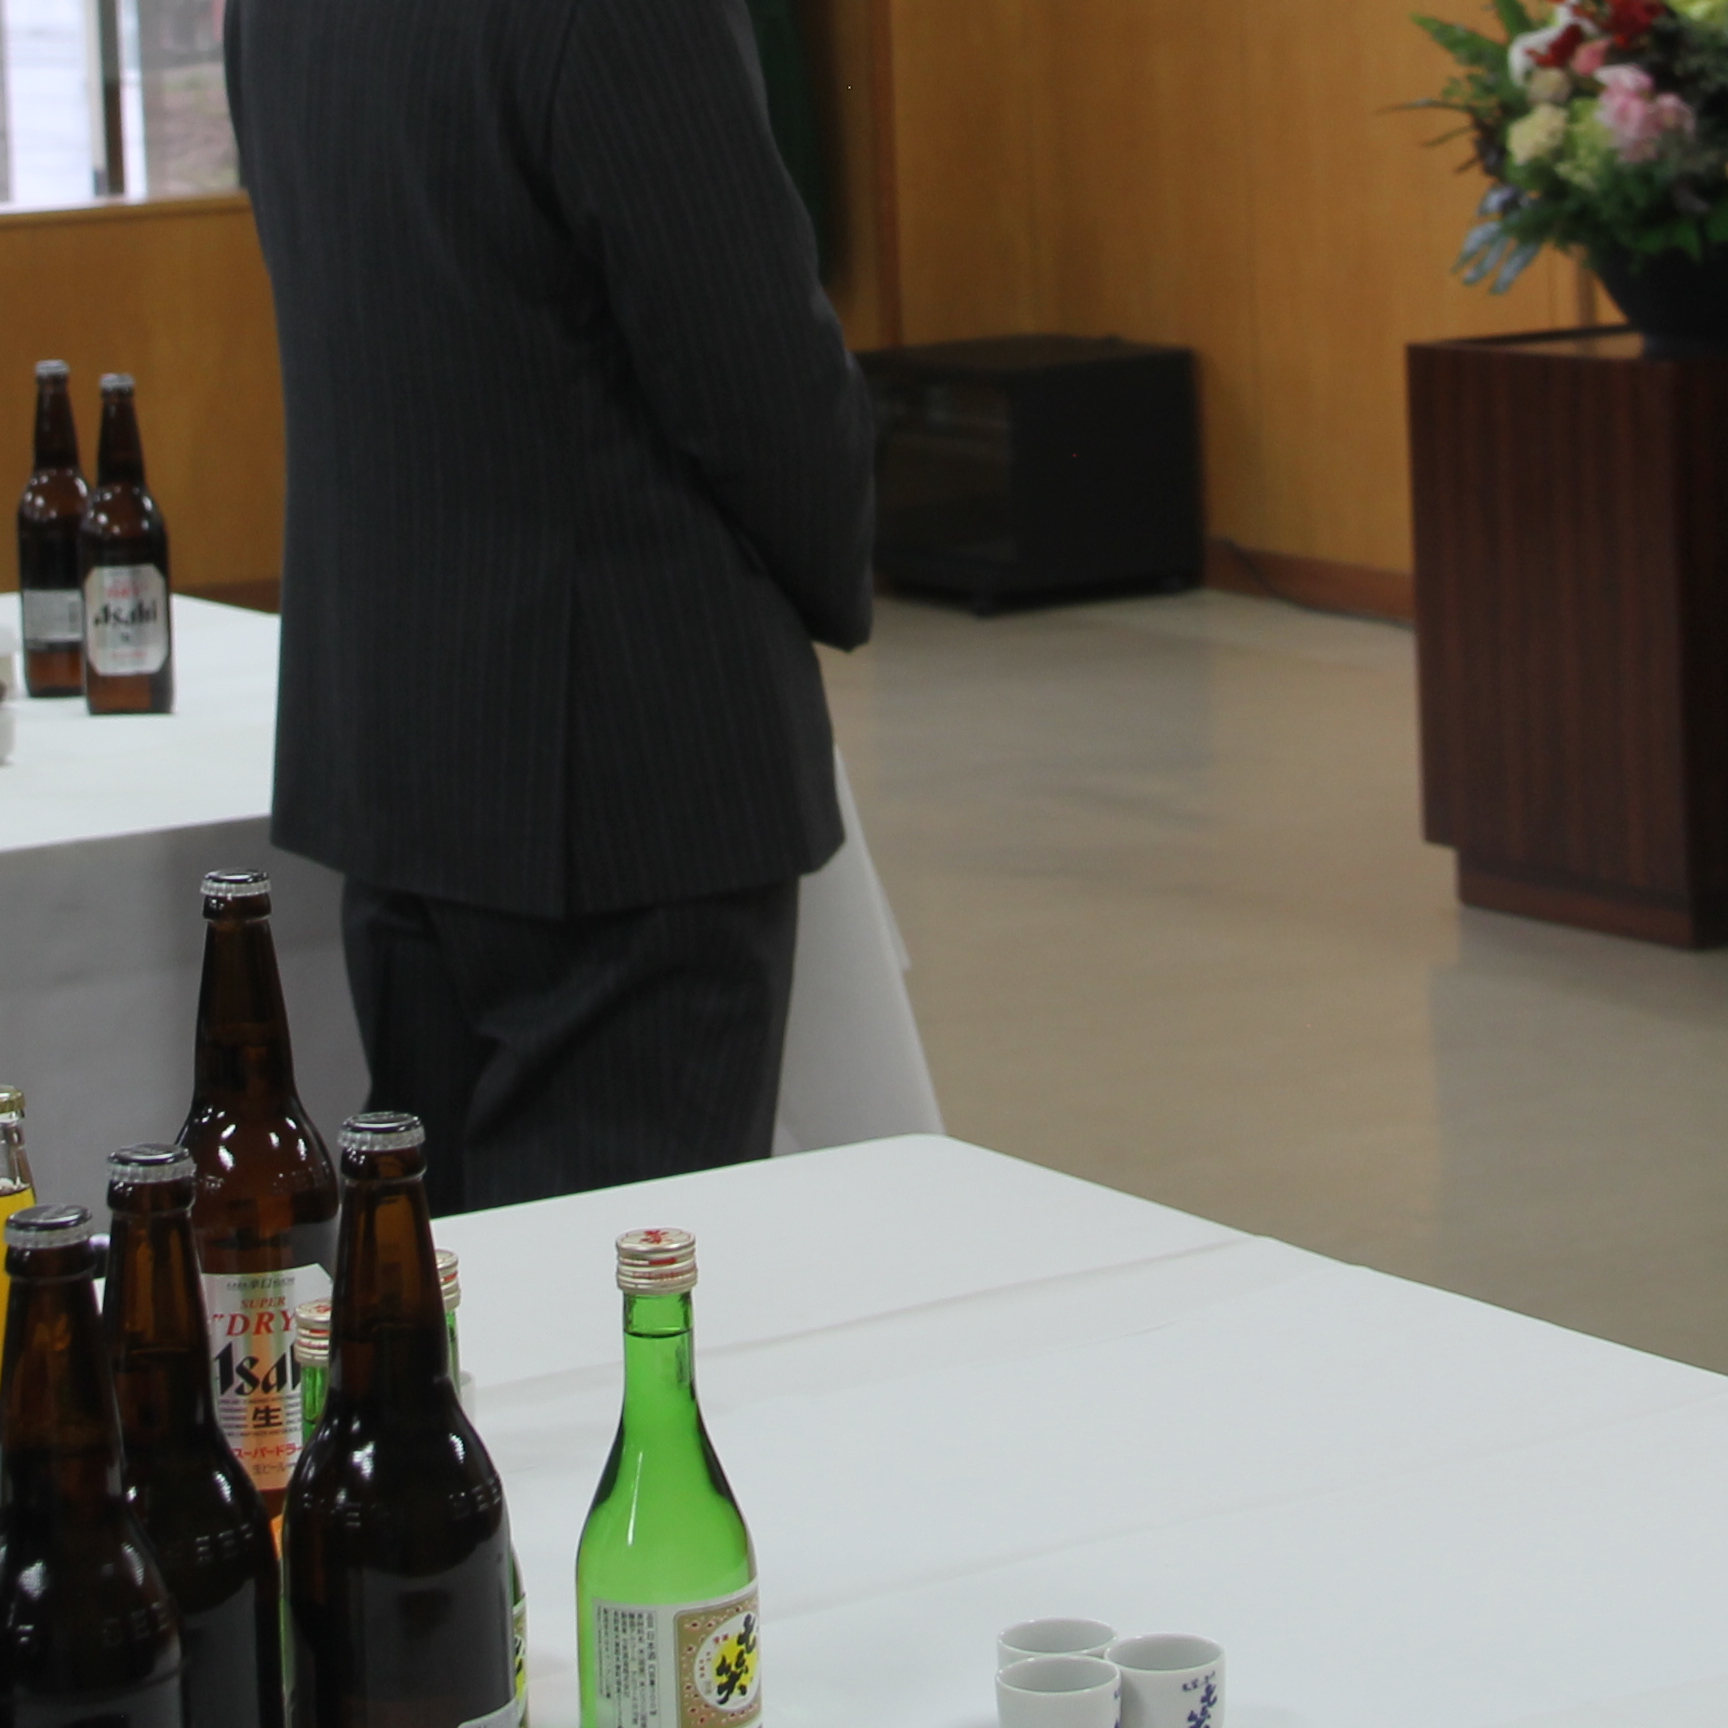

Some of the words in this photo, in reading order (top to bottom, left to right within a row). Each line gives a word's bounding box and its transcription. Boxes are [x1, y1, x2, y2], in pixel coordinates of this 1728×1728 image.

[241, 1295, 286, 1309] SUPER
[214, 1342, 302, 1396] Asa
[252, 1405, 283, 1429] 生
